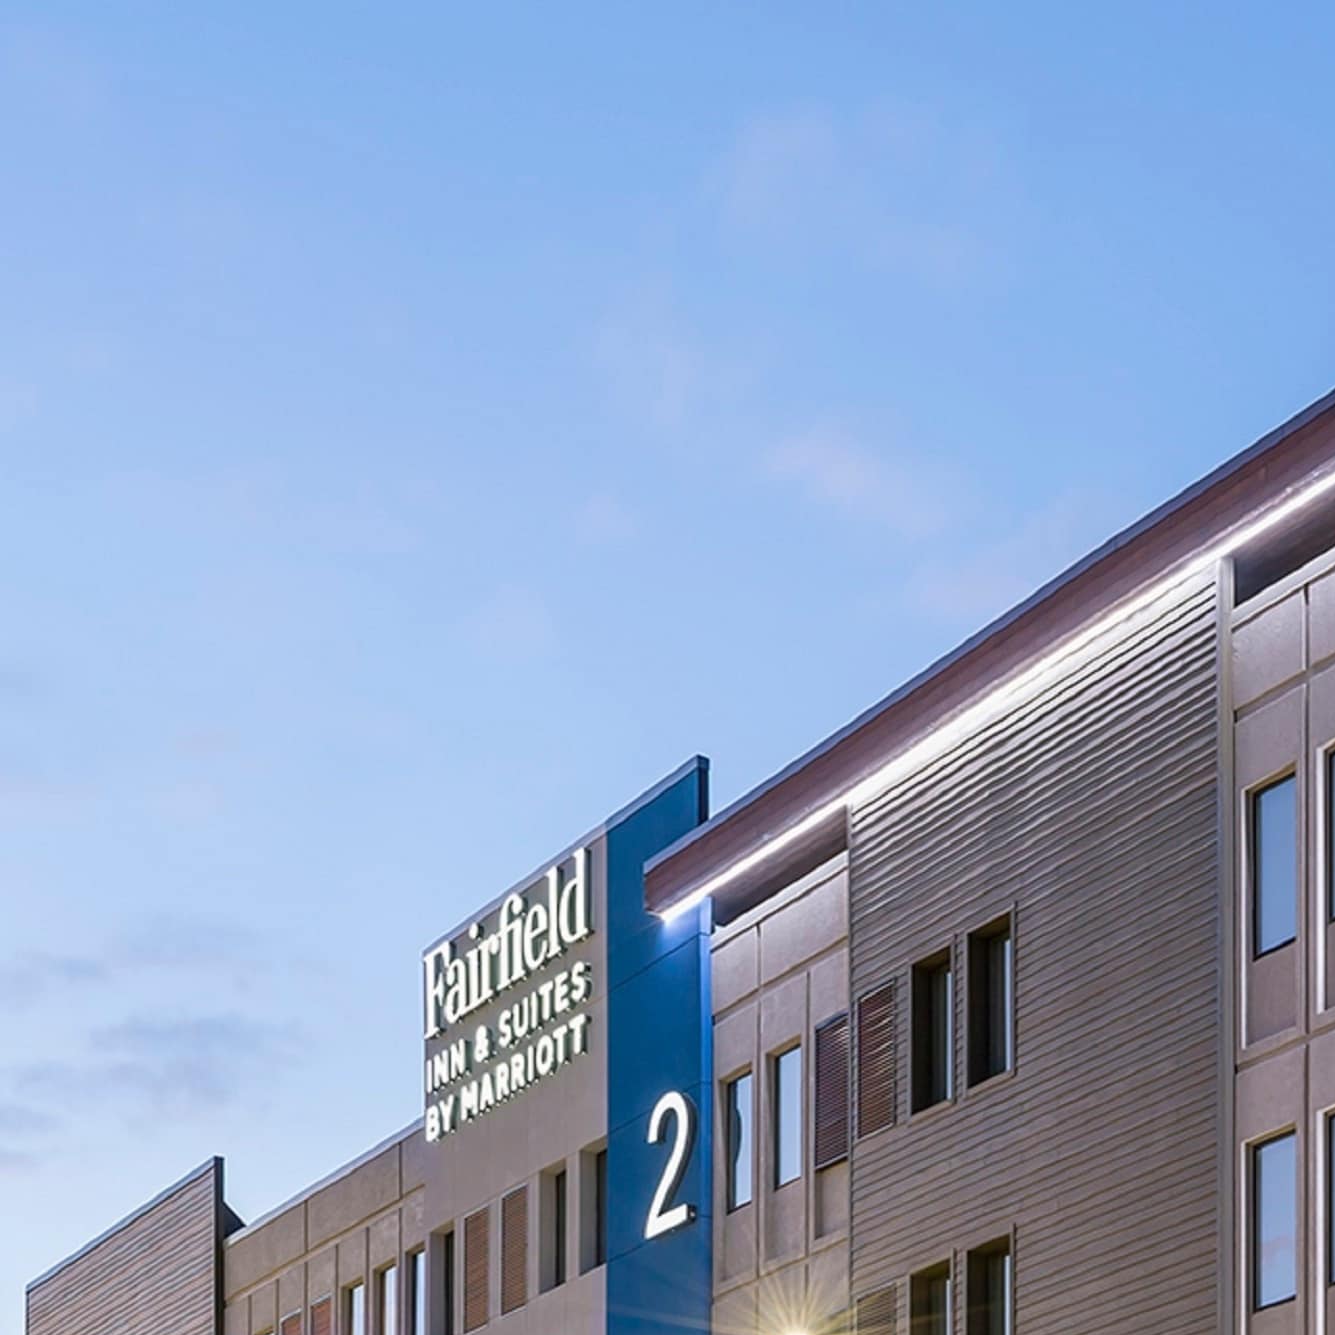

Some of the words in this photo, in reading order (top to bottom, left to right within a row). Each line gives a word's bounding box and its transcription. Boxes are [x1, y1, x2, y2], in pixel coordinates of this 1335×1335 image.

[424, 847, 589, 1040] Fairfield
[425, 1095, 455, 1142] BY
[461, 1013, 588, 1121] MARRIOTT
[426, 1038, 466, 1093] INN
[473, 1025, 490, 1062] &
[499, 961, 586, 1048] SUITES
